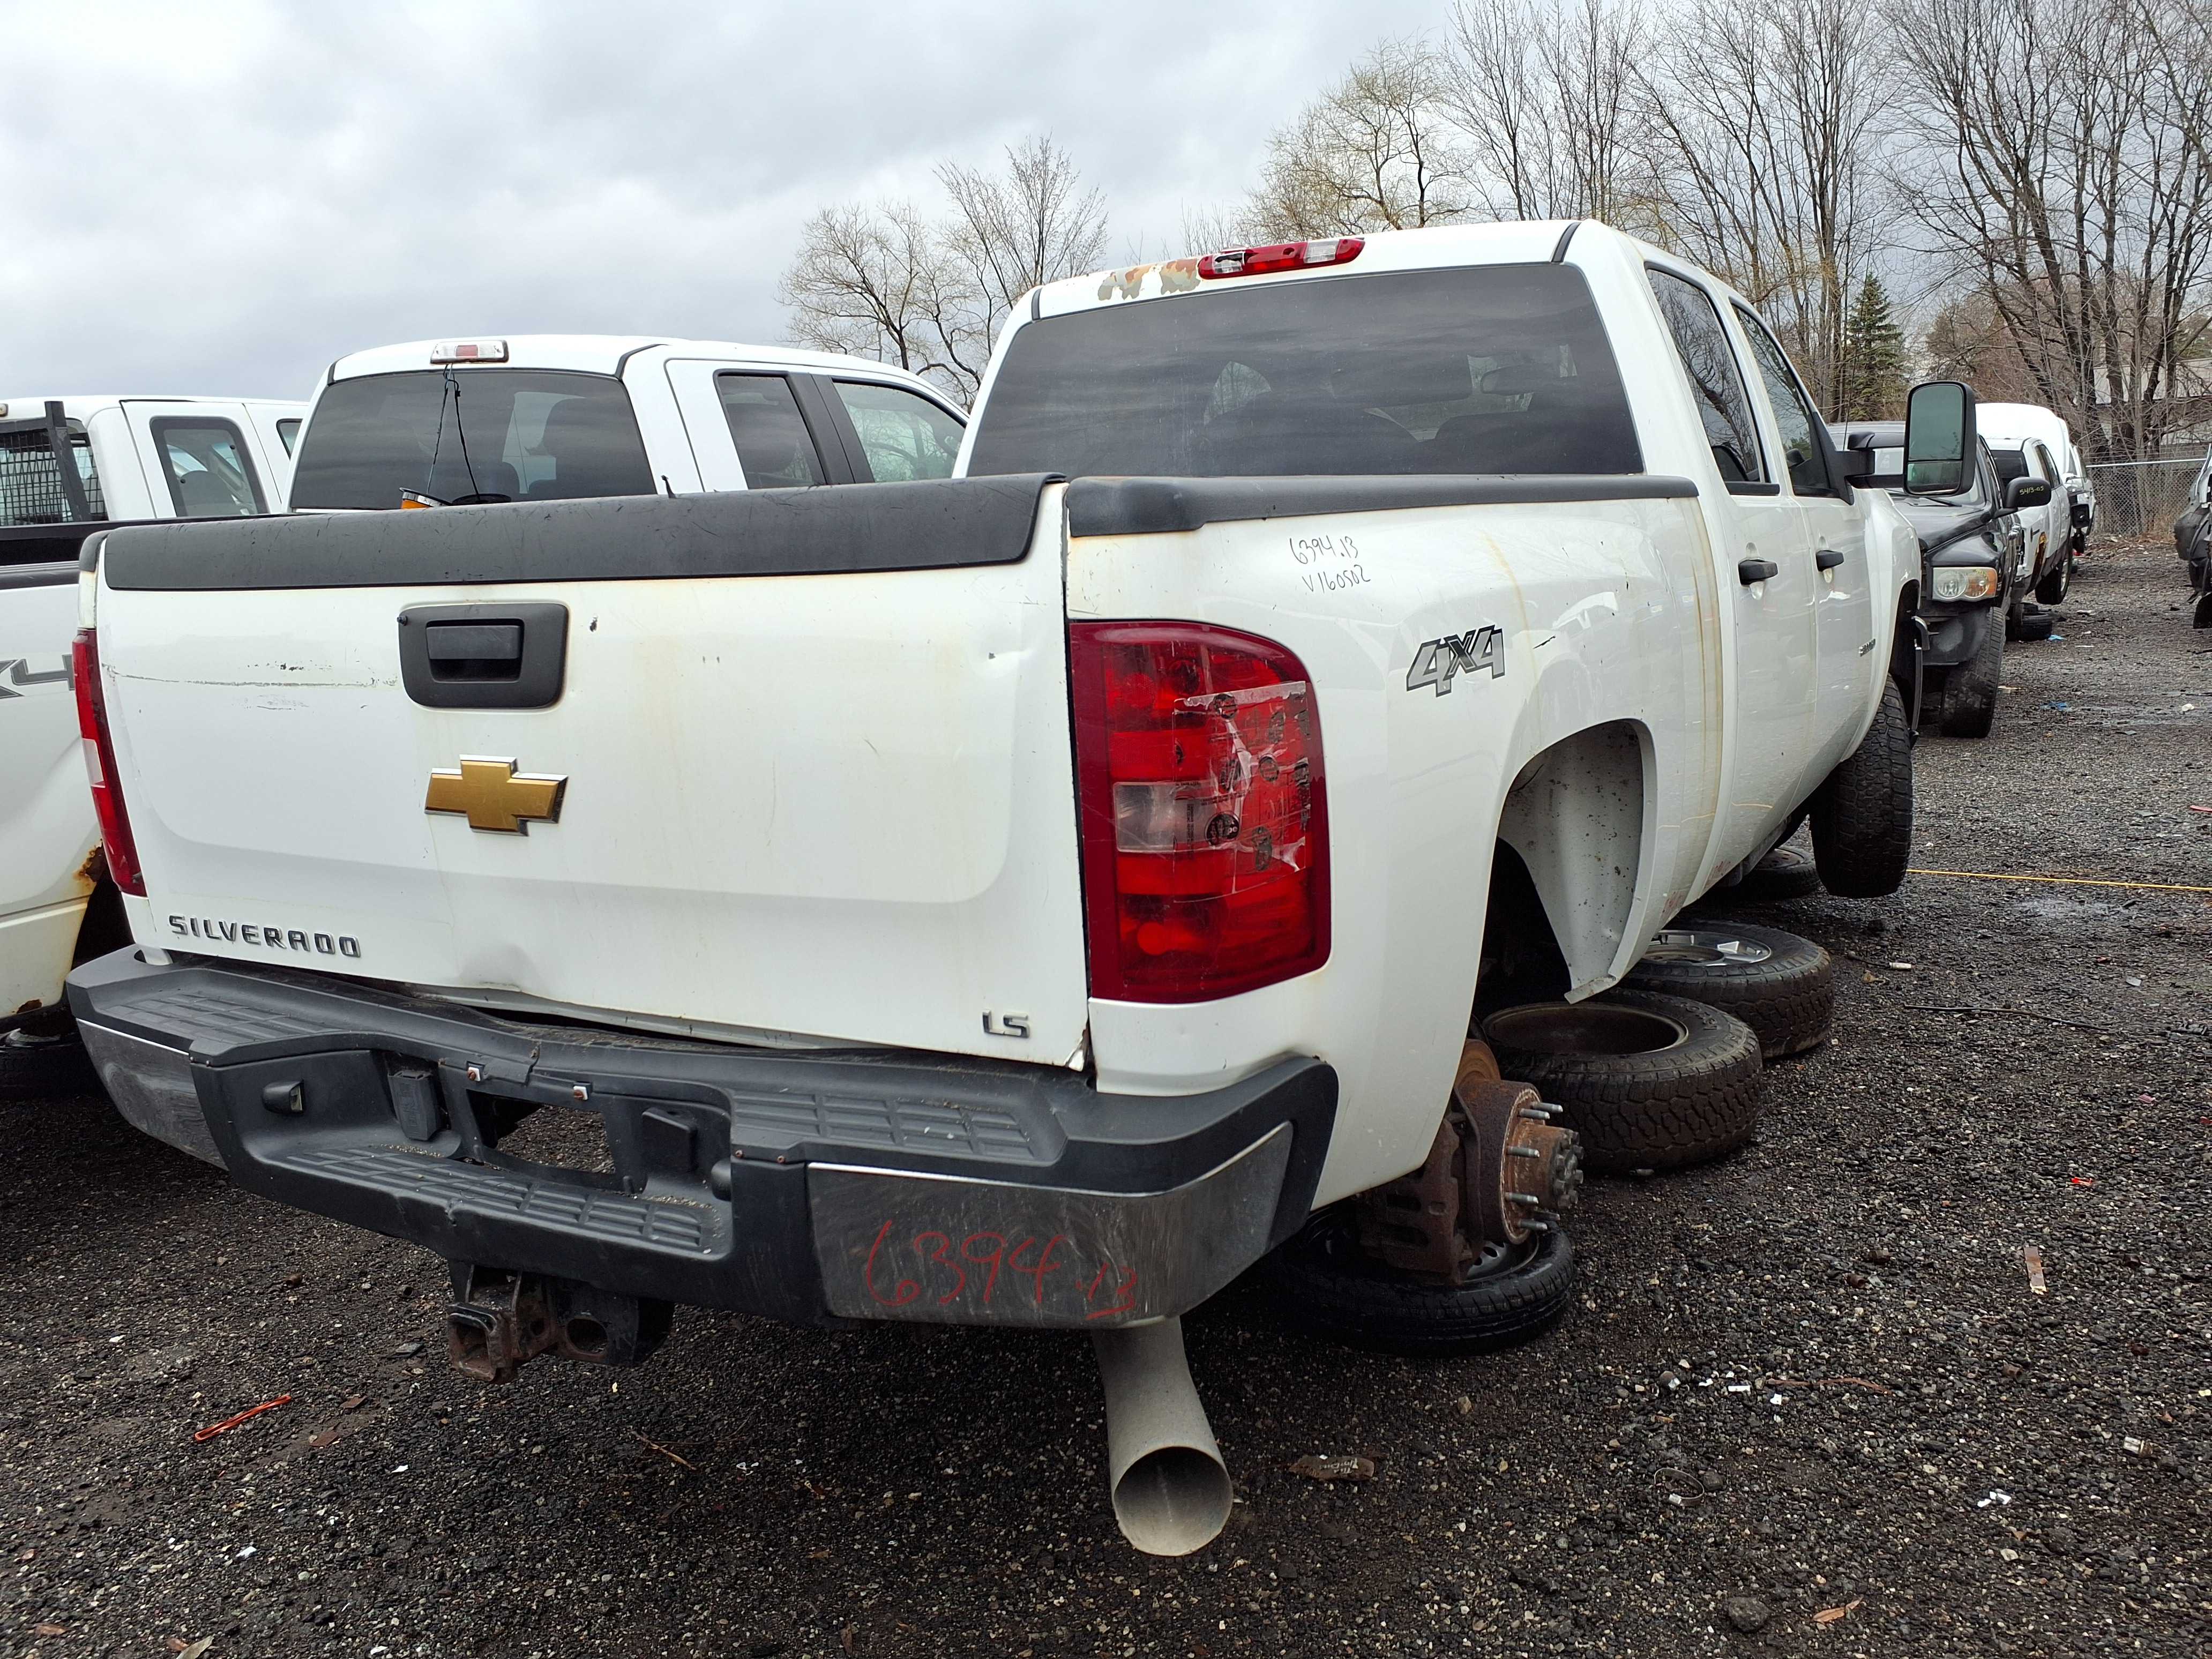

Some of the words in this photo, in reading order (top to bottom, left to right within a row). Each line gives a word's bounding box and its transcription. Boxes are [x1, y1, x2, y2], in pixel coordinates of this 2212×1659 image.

[1289, 535, 1358, 564] 6394.13
[168, 914, 361, 958] SILVERADO
[982, 1009, 1030, 1038] LS
